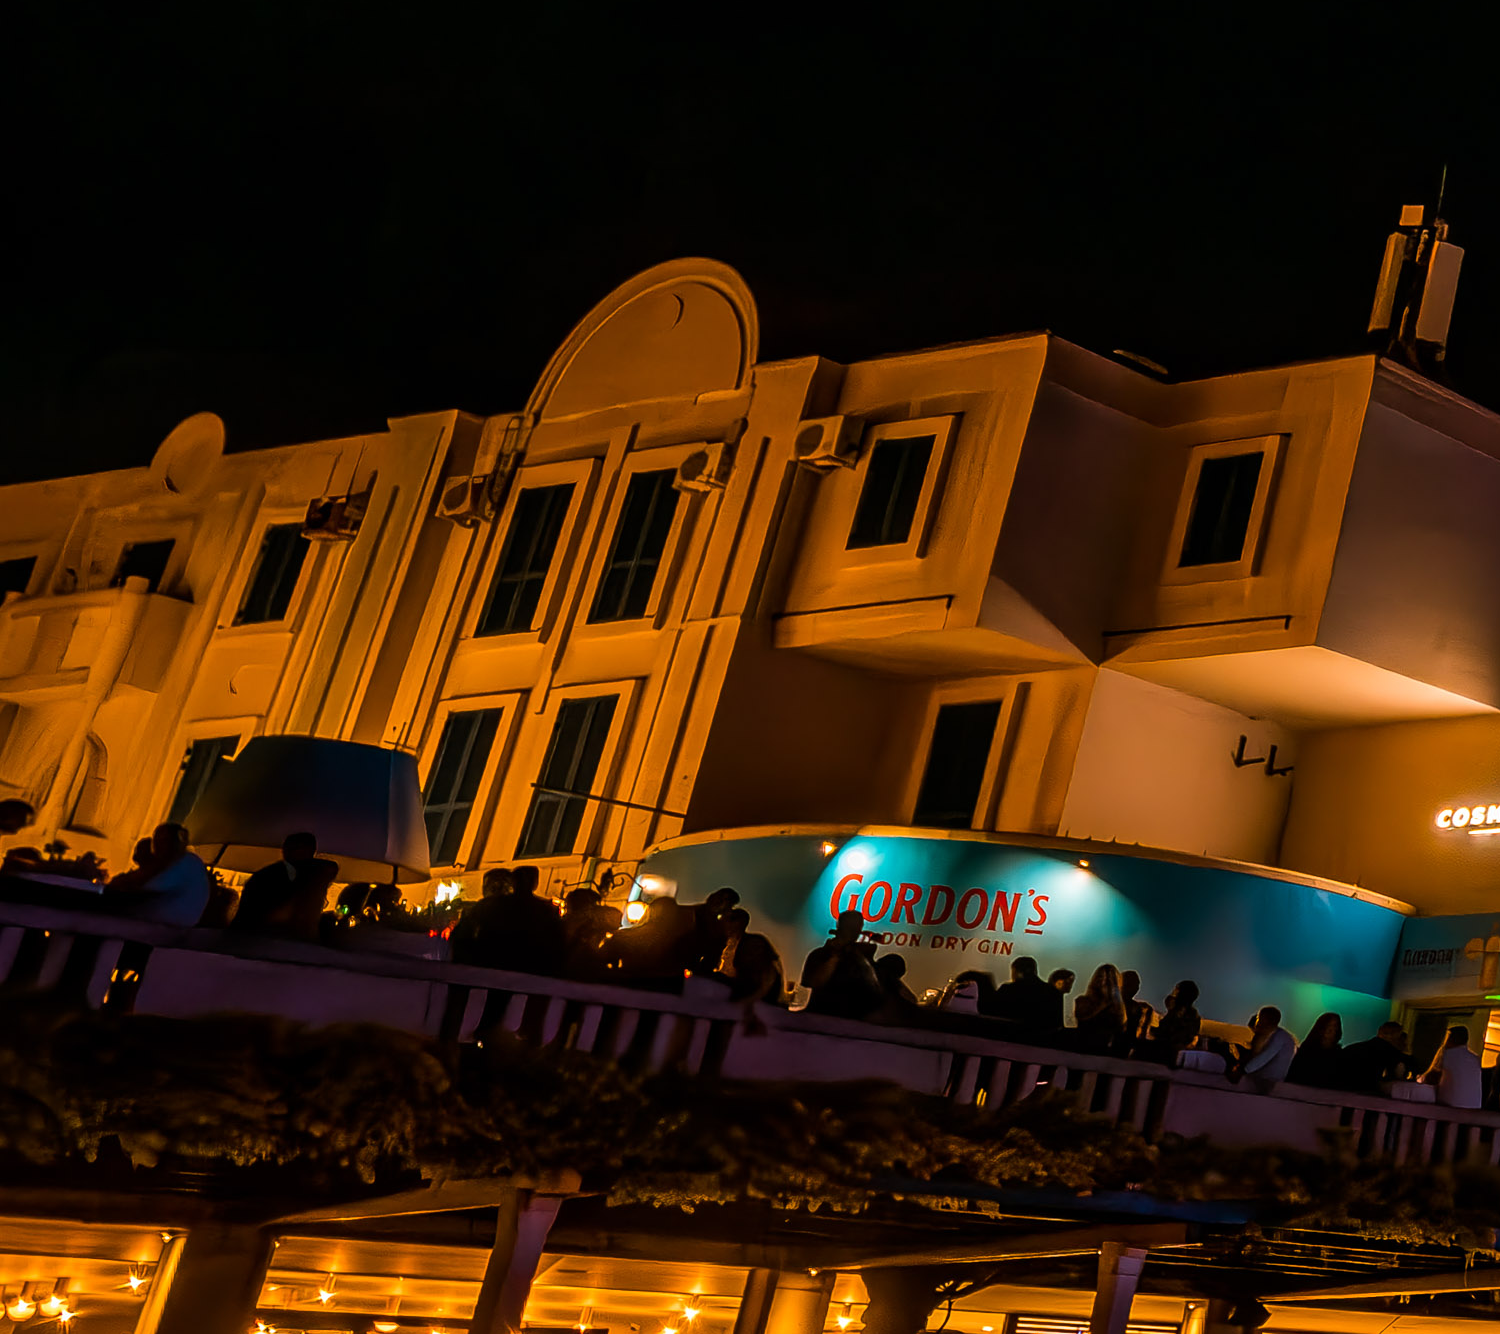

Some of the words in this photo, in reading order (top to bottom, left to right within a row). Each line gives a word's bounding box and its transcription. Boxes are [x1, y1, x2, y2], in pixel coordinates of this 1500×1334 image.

[829, 873, 1050, 935] GORDON'S
[930, 936, 974, 950] DRY
[977, 939, 1014, 956] GIN
